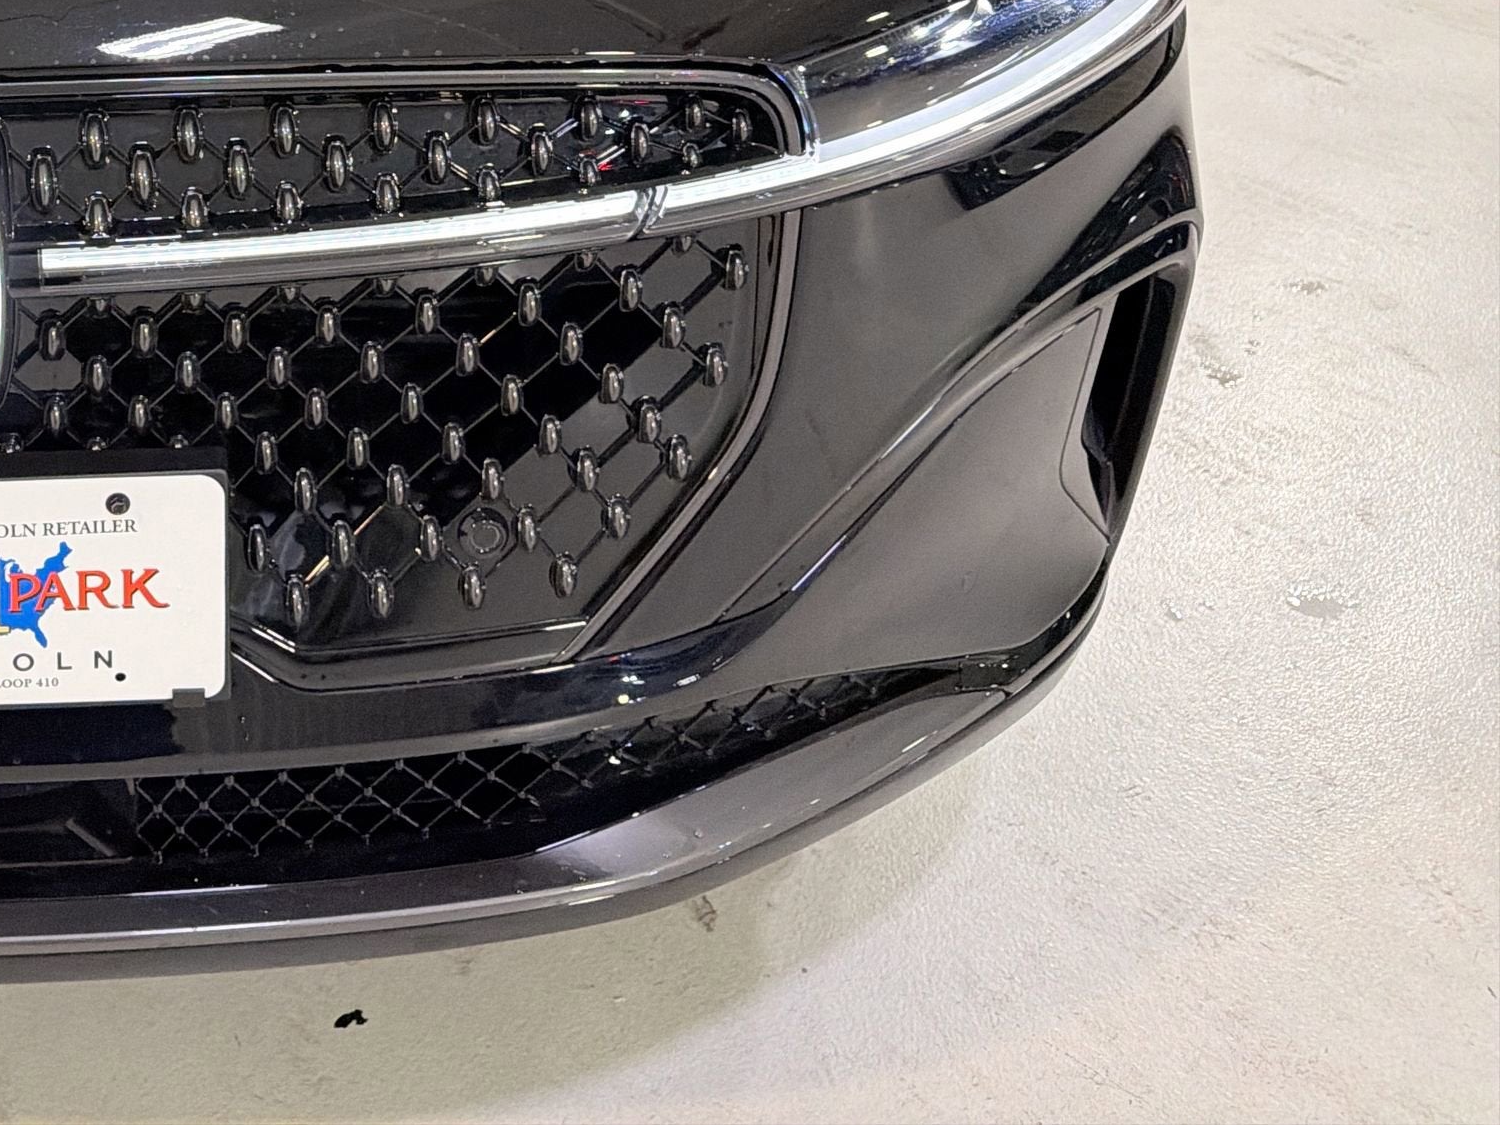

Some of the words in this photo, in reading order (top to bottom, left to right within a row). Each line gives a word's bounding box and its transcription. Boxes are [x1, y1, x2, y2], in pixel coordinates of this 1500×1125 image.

[42, 519, 138, 537] RETAILER
[8, 568, 171, 613] PARK
[35, 677, 60, 688] 410
